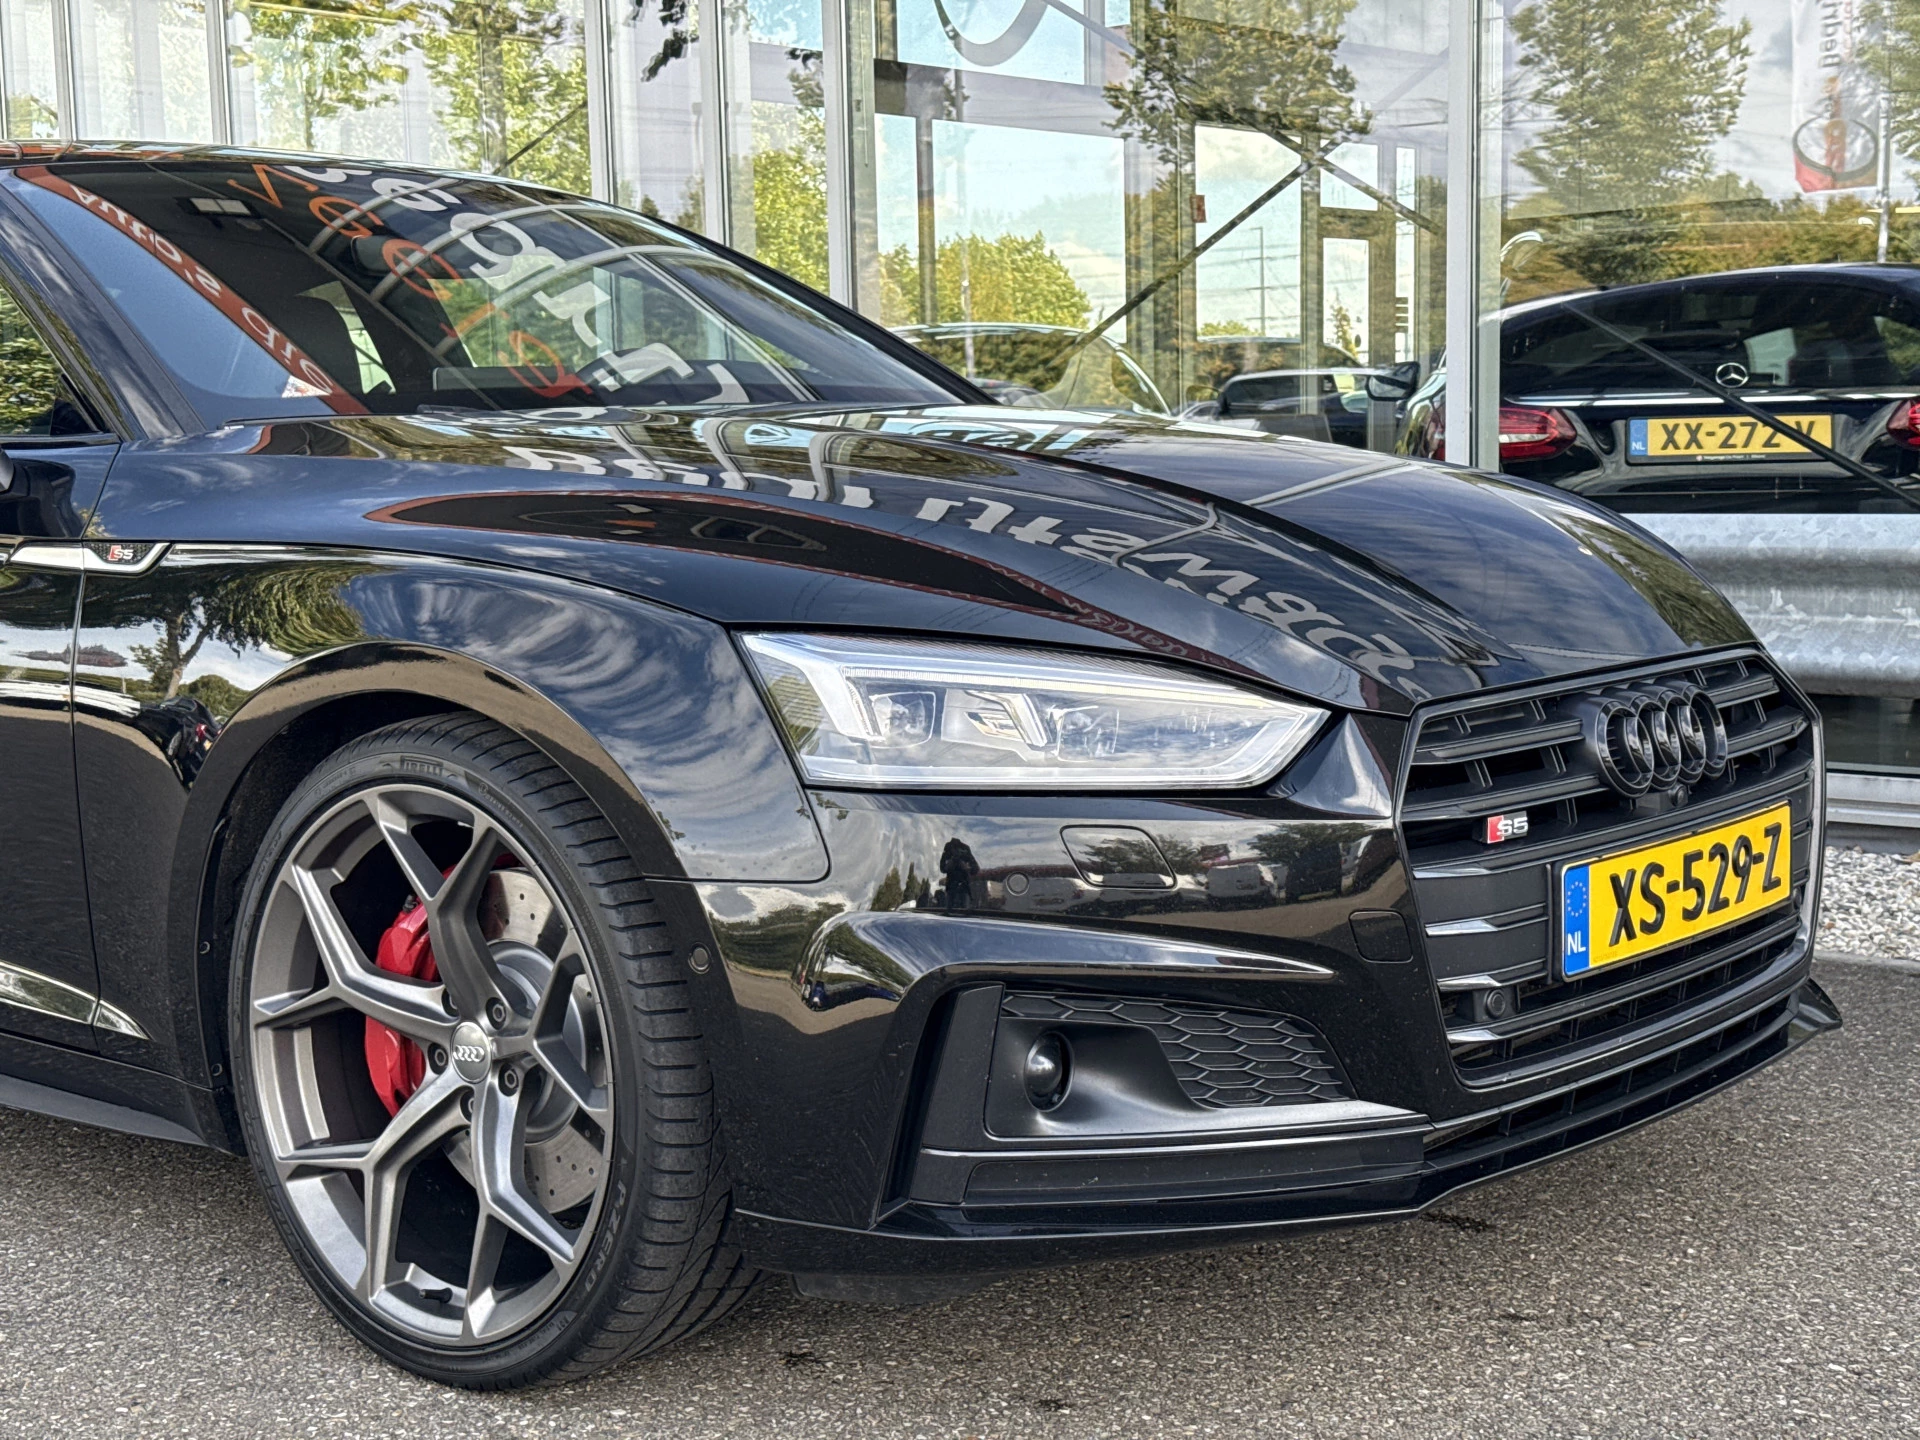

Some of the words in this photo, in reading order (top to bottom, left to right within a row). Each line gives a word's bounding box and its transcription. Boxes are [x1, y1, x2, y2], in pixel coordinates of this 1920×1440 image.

[1631, 441, 1646, 451] NL
[111, 547, 134, 560] S5
[1494, 815, 1529, 837] S5
[1608, 821, 1784, 947] XS-529-Z
[1566, 932, 1587, 956] NL
